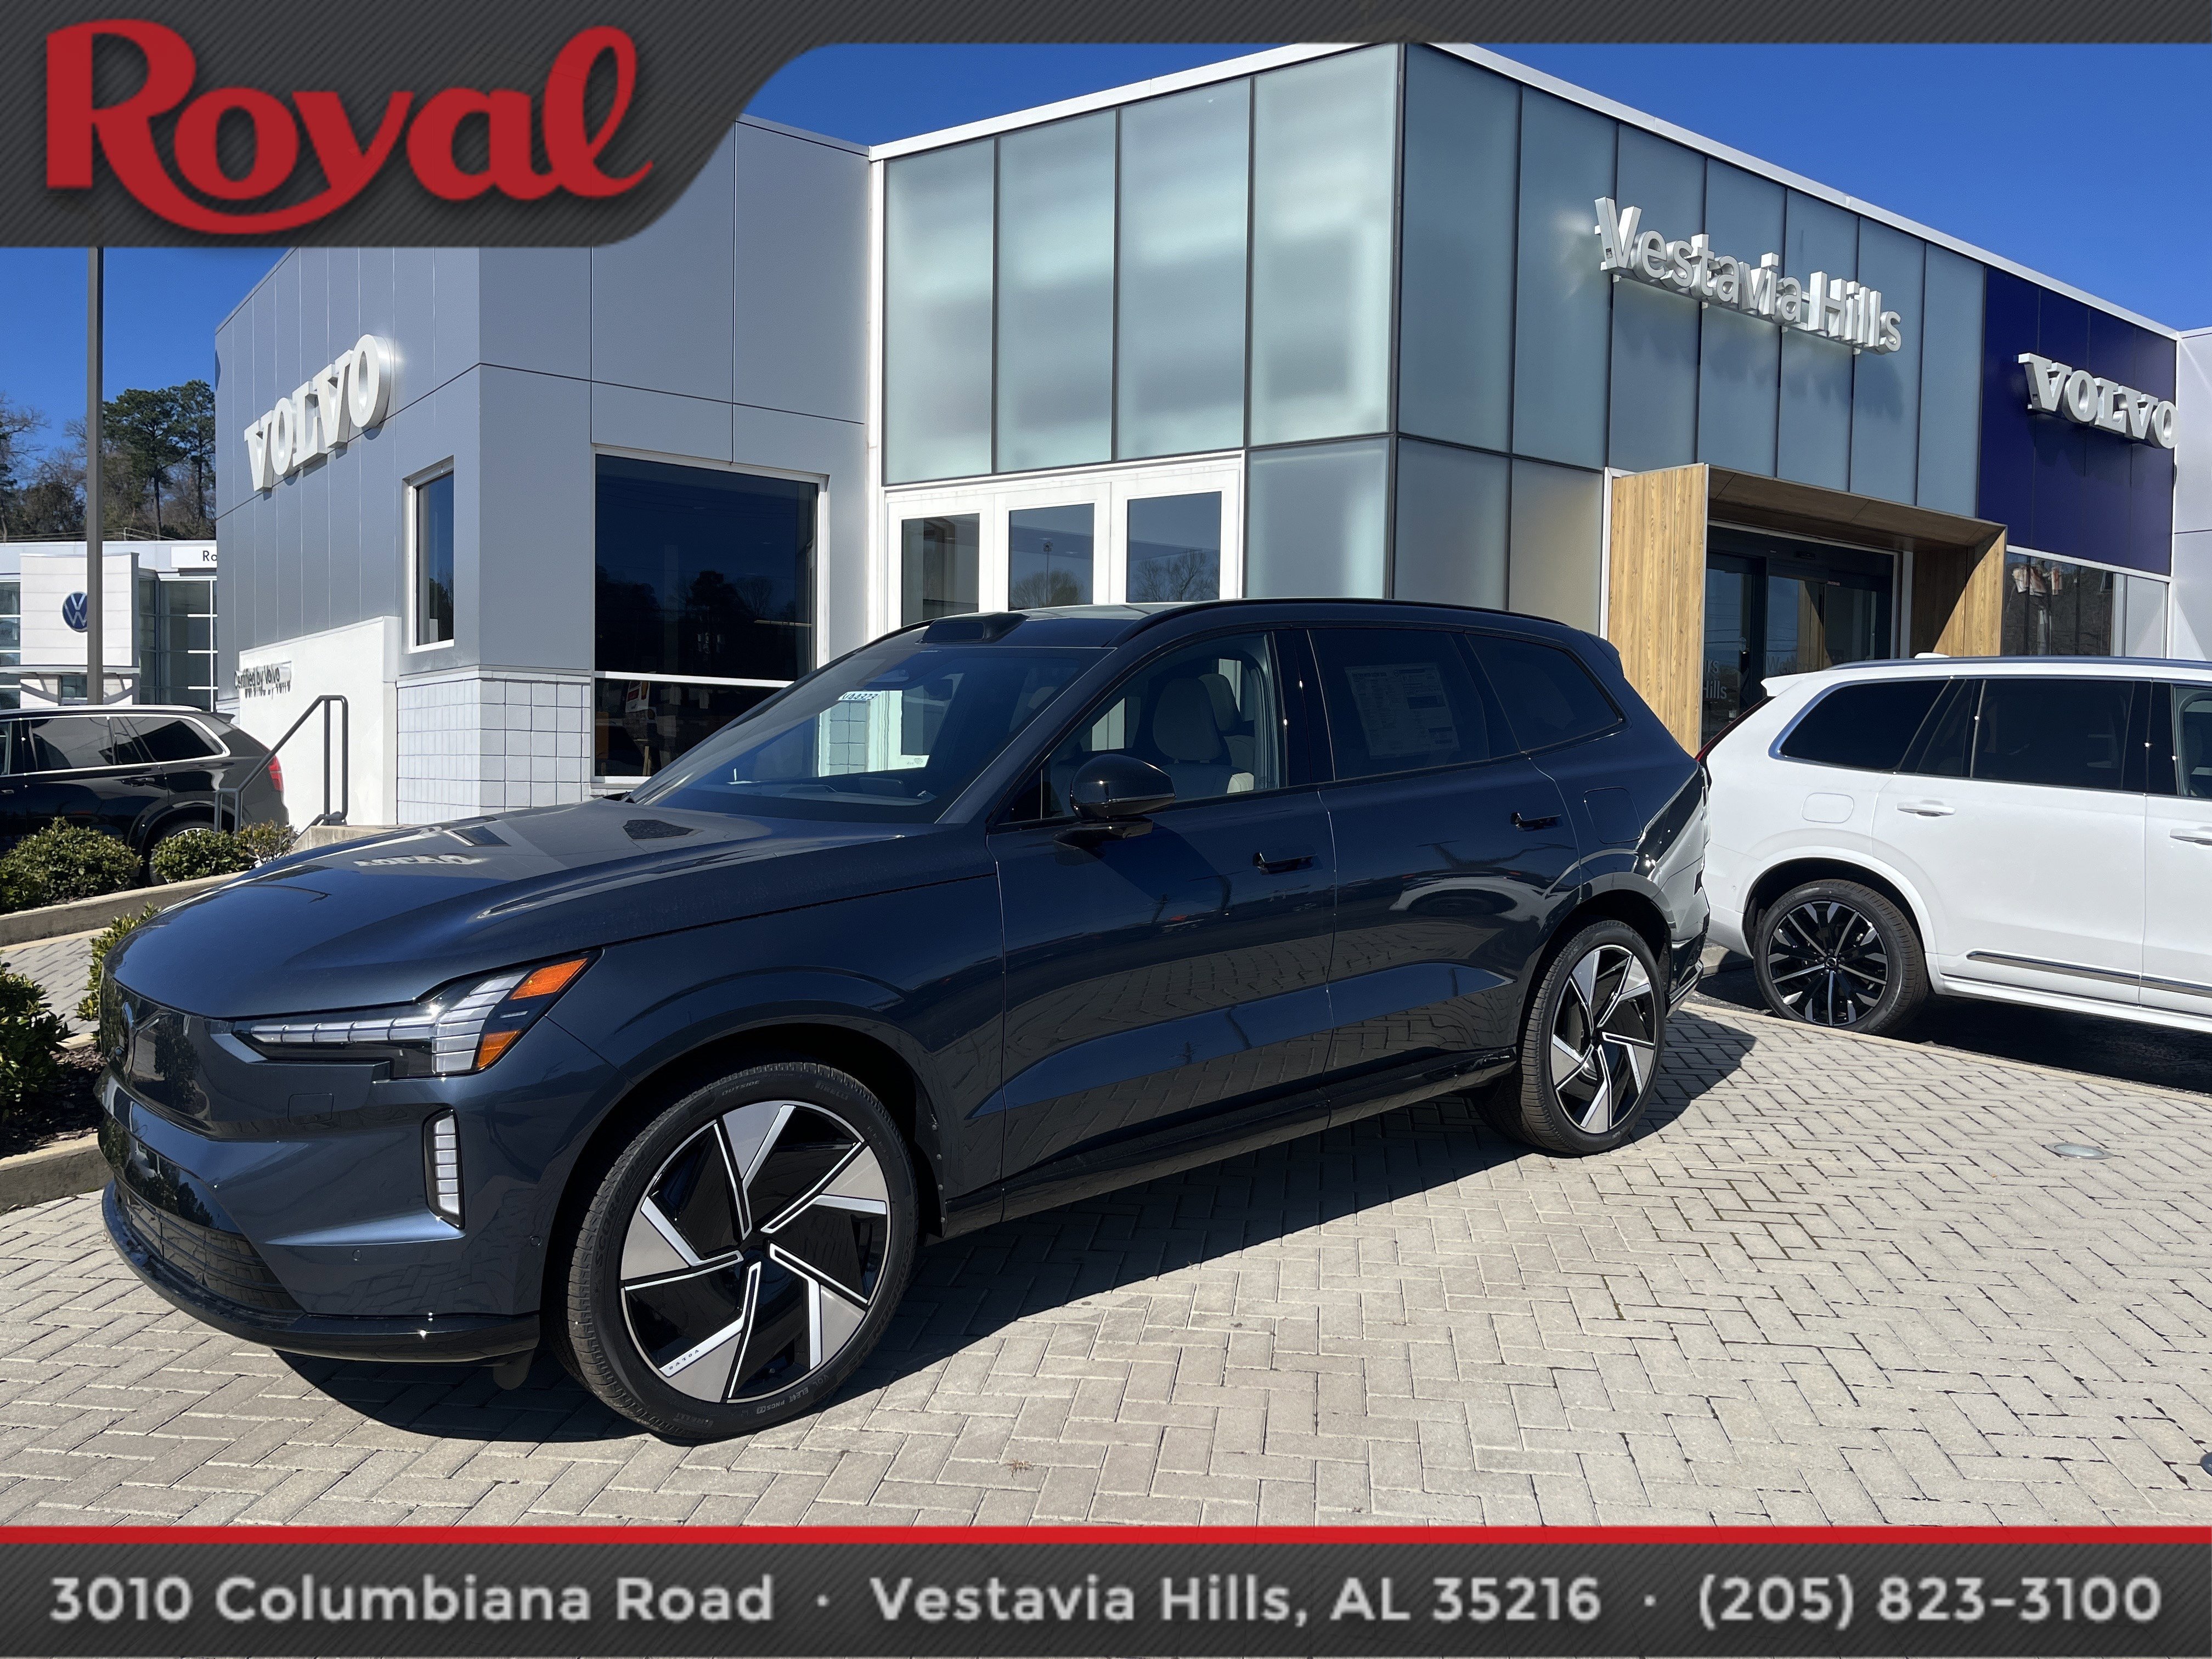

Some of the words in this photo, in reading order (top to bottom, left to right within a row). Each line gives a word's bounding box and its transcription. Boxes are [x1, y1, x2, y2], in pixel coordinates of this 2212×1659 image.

[1594, 196, 1802, 325] Vestavia
[1808, 270, 1901, 354] Hills
[244, 334, 391, 492] VOLVO
[2018, 353, 2180, 449] VOLVO
